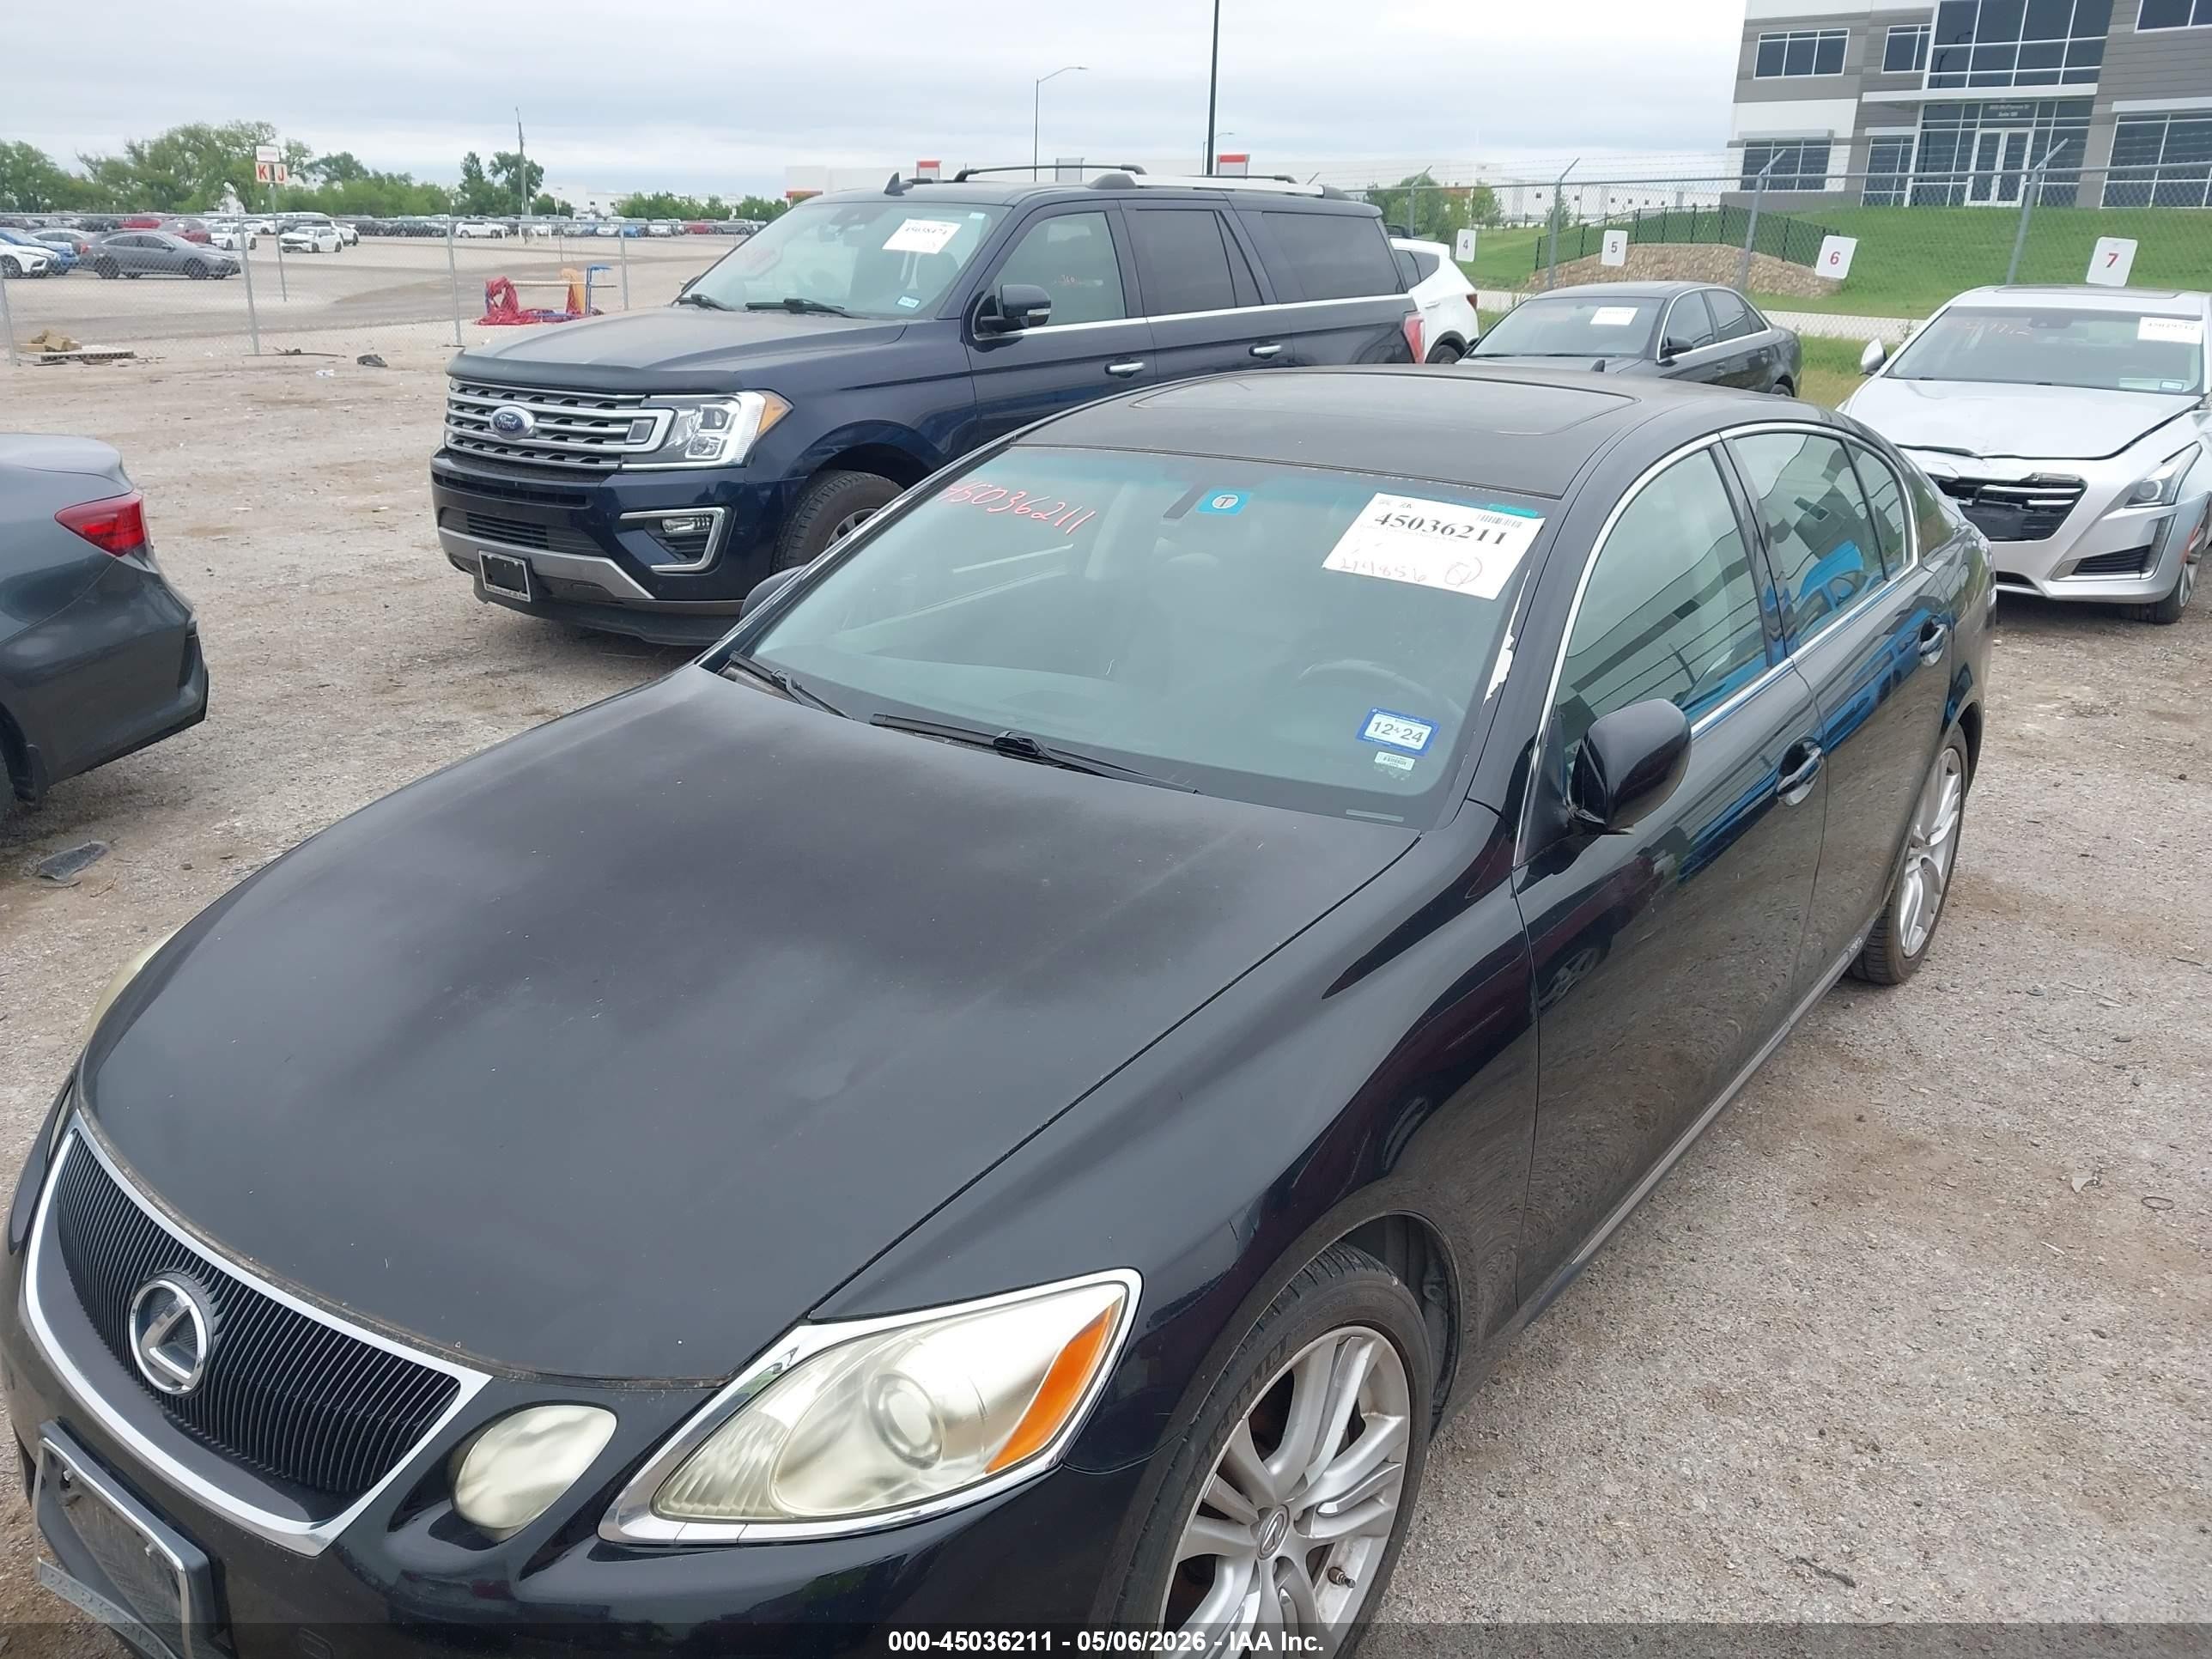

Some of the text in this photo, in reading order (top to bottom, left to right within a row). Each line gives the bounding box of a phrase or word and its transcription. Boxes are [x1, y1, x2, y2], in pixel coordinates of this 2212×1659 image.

[258, 164, 284, 181] K J
[1462, 239, 1468, 250] 4
[1611, 241, 1618, 253] 5
[1830, 251, 1840, 265] 6
[2106, 252, 2119, 268] 7
[497, 413, 518, 428] Ford
[936, 479, 1096, 535] 45036211
[1374, 512, 1508, 545] 45036211
